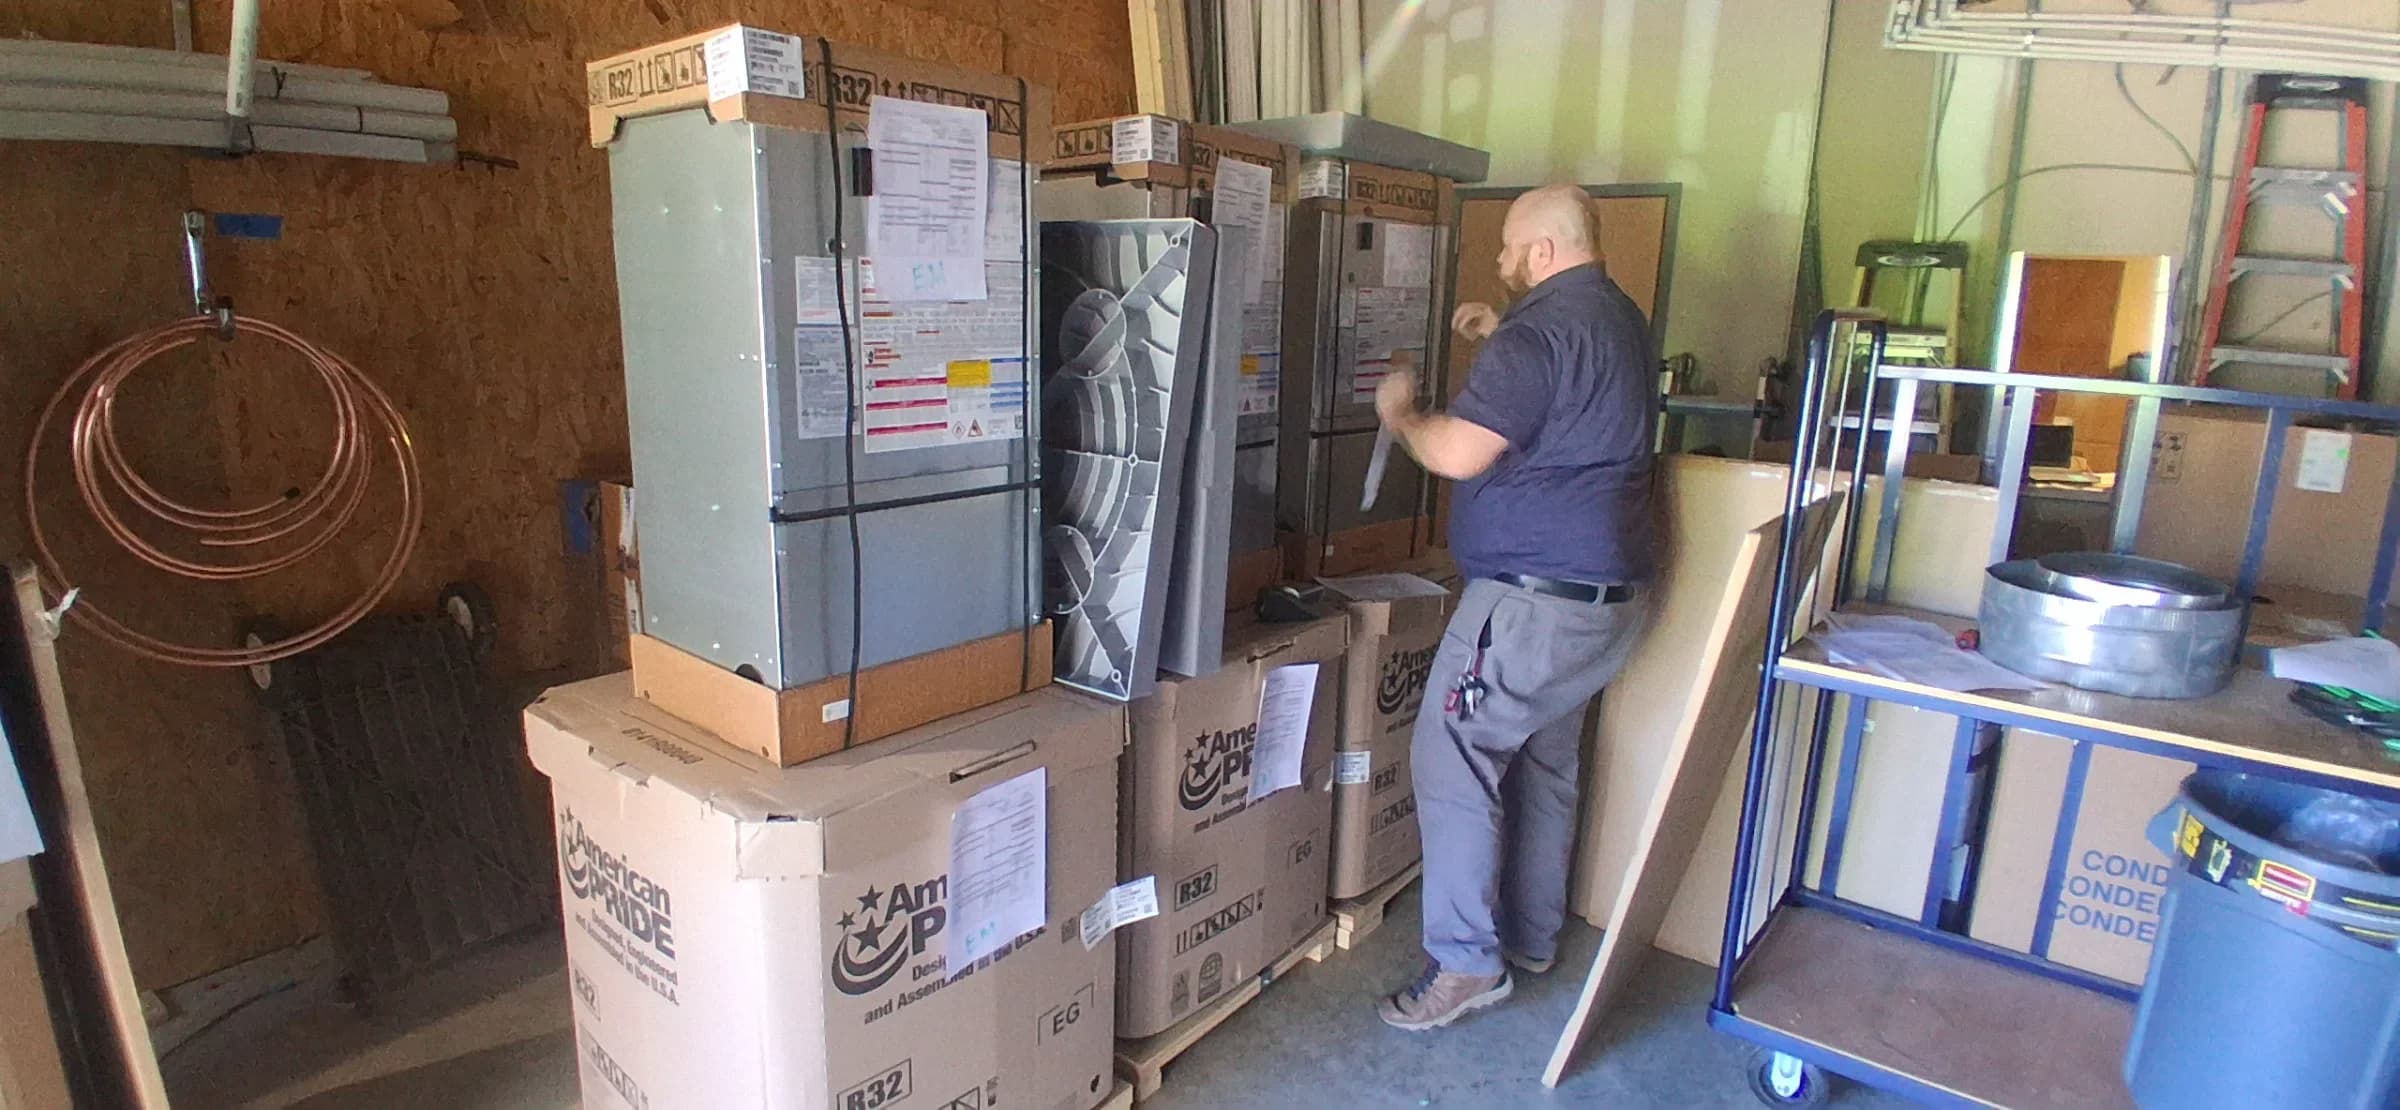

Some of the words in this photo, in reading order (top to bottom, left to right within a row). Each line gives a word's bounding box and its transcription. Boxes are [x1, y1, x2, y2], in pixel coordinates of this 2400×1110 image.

[608, 69, 633, 100] R32
[829, 72, 871, 106] R32
[575, 820, 671, 916] American
[1295, 840, 1312, 865] EG
[1180, 872, 1212, 904] R32
[588, 861, 676, 960] PRIDE
[575, 966, 597, 1010] R32
[863, 999, 894, 1025] and
[1053, 1002, 1080, 1035] EG
[847, 1070, 902, 1110] R32
